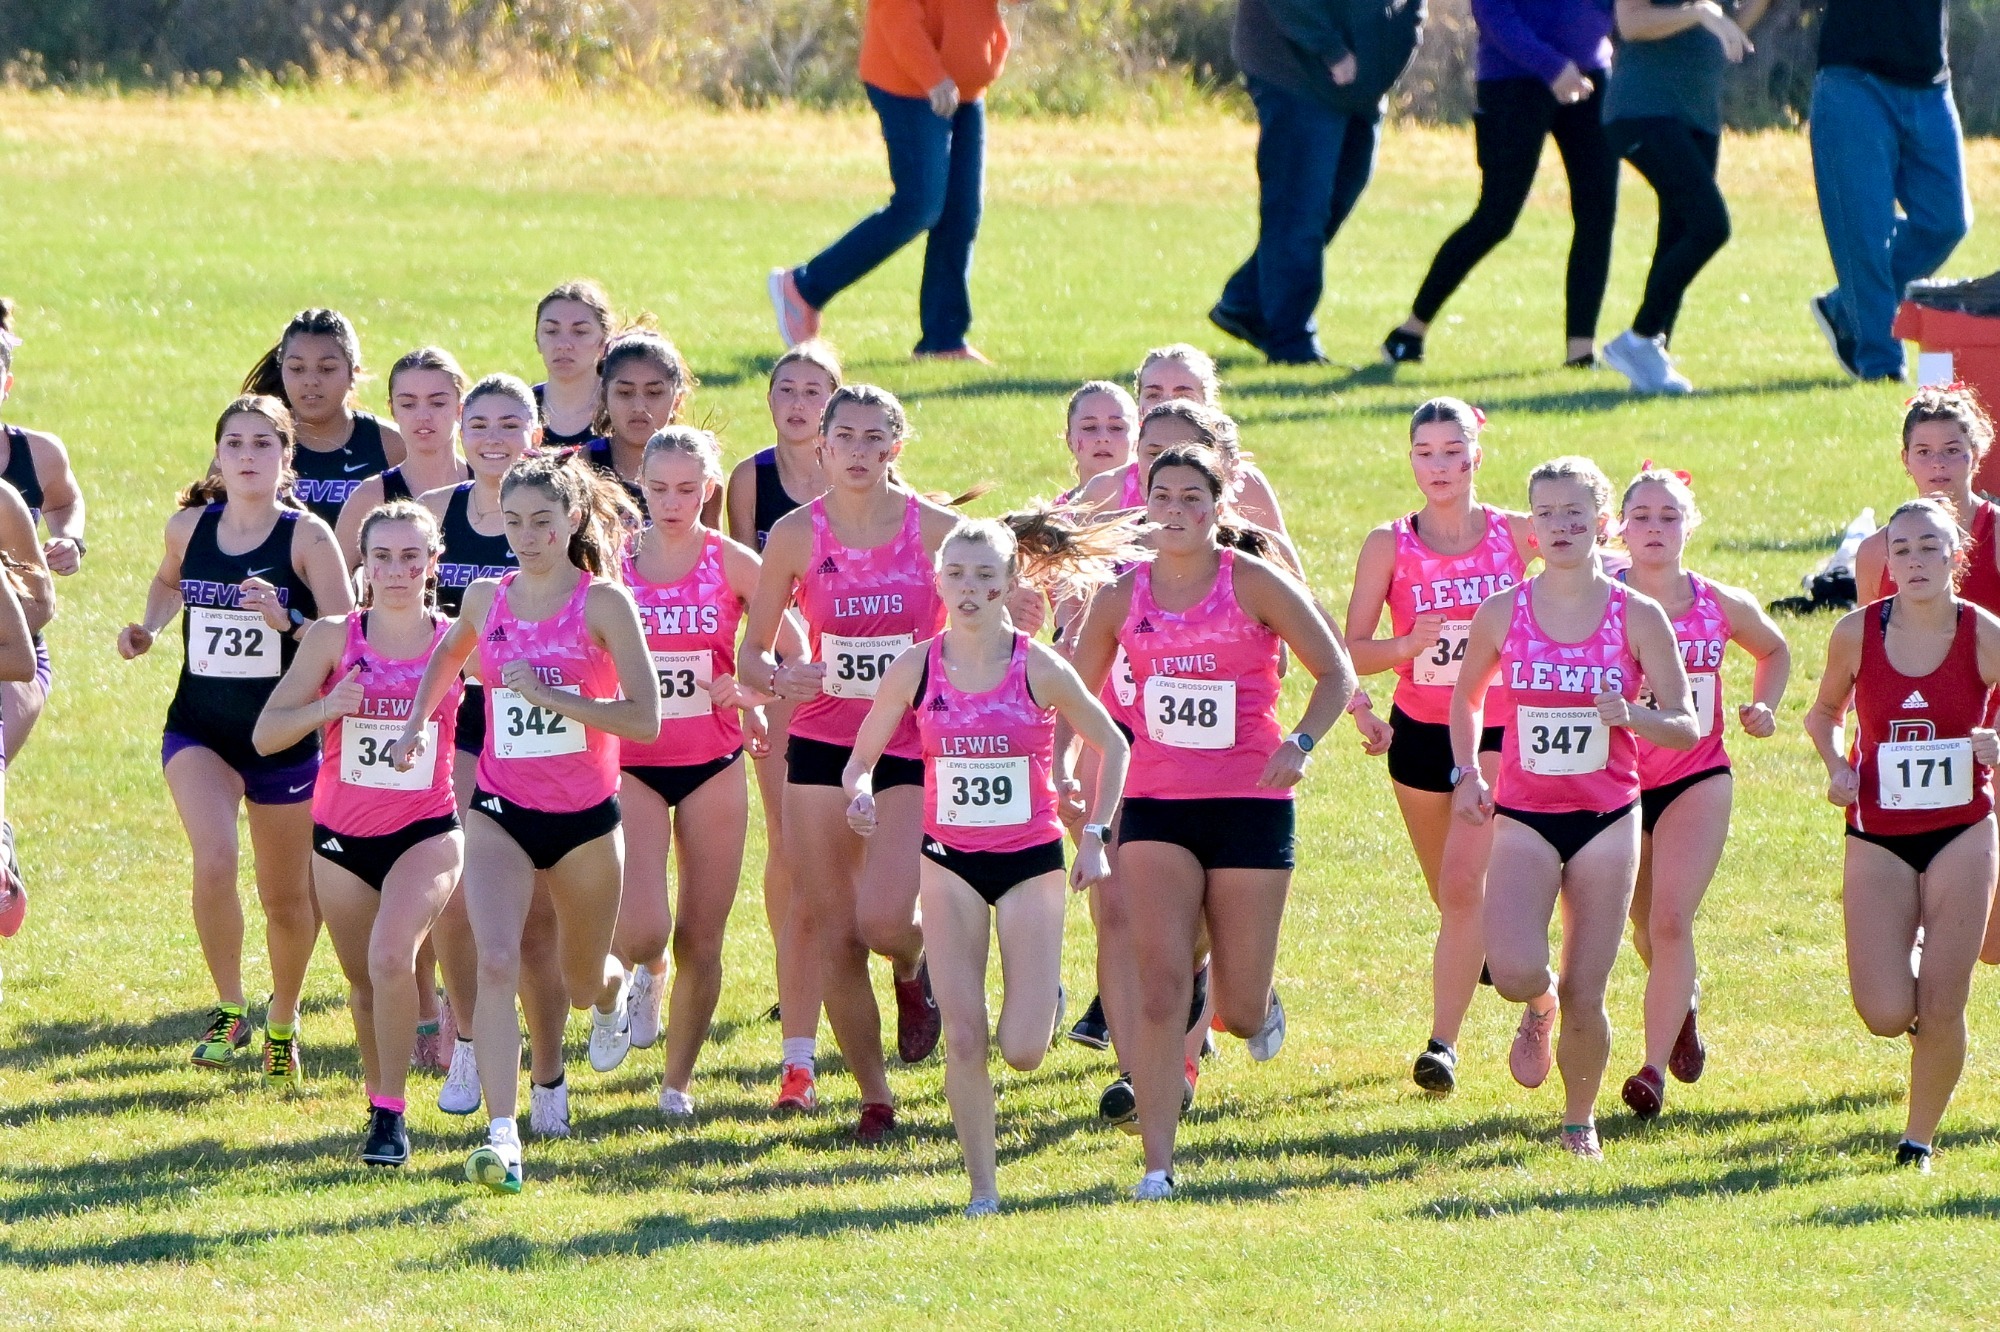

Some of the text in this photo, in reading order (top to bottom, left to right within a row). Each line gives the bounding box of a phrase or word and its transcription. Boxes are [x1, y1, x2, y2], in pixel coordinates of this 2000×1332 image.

[179, 579, 289, 608] TREVEA
[834, 594, 904, 618] LEWIS
[201, 612, 266, 622] LEWIS CROSSOVE
[639, 604, 719, 635] EWIS
[205, 626, 264, 657] 732
[831, 638, 901, 649] LEWIS CROSSOVER
[1431, 637, 1469, 667] 34
[654, 655, 701, 663] CROSSOVER
[836, 653, 897, 682] 350
[1151, 653, 1218, 676] LEWIS
[657, 669, 696, 699] 53
[1155, 680, 1223, 692] LEWIS CROSSOVER
[1510, 661, 1624, 695] LEWIS
[363, 698, 412, 717] LEW
[507, 706, 567, 737] 342
[1159, 695, 1218, 728] 348
[1527, 711, 1598, 719] LEWIS CROSSOVER
[355, 721, 406, 732] LEWIS CROSS
[1531, 725, 1593, 755] 347
[358, 737, 398, 768] 34
[940, 734, 1010, 756] LEWIS
[1890, 742, 1961, 752] LEWIS CROSSOVER
[946, 761, 1017, 770] LEWIS CROSSOVER
[1896, 756, 1953, 788] 171
[951, 775, 1013, 806] 339
